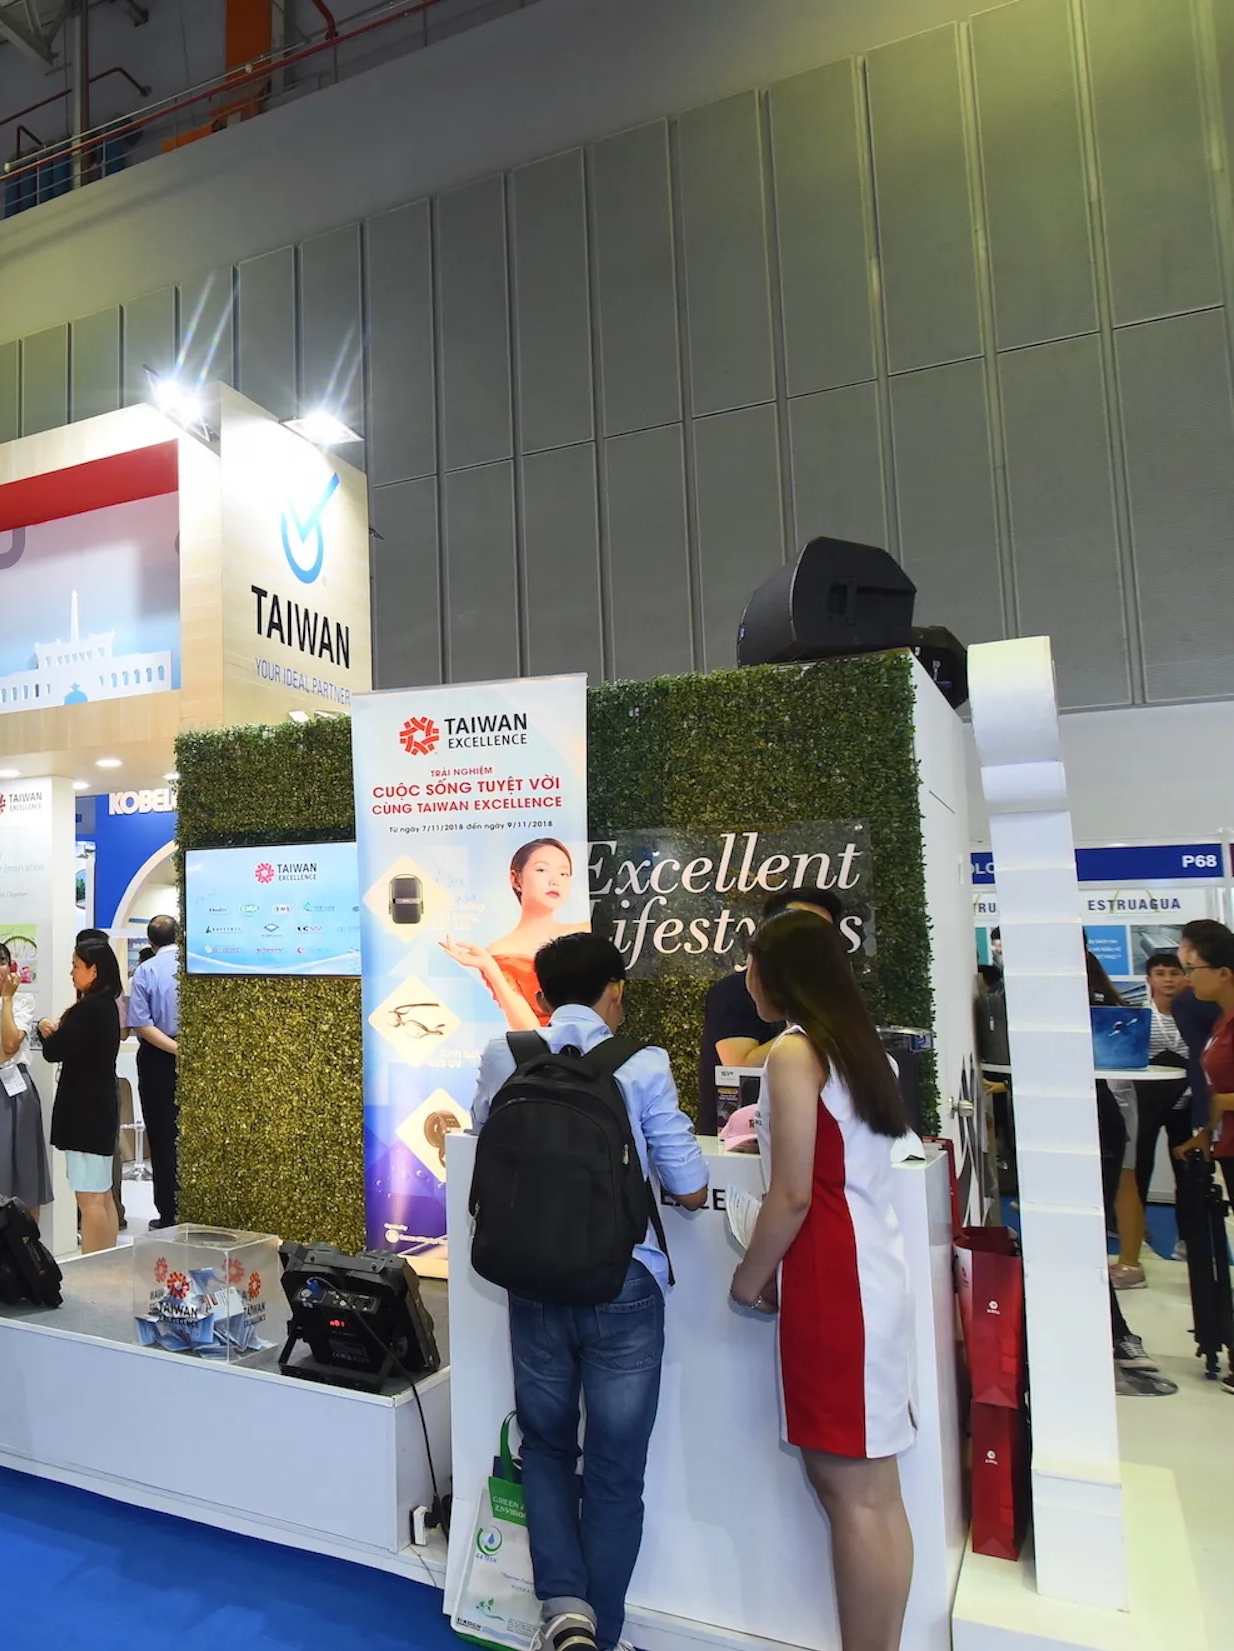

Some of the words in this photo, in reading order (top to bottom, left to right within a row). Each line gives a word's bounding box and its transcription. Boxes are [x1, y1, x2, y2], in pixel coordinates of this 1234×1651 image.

[251, 585, 350, 669] TAIWAN
[255, 658, 282, 683] YOUR
[283, 665, 311, 693] IDEAL
[312, 678, 351, 706] PARTNER
[444, 713, 528, 735] TAIWAN
[448, 733, 528, 749] EXCELLENCE
[373, 782, 421, 801] CUỘC
[426, 779, 472, 796] SỐNG
[478, 776, 523, 795] TUYỆT
[529, 774, 560, 790] VỜI
[8, 792, 43, 803] TAIWAN
[372, 801, 412, 815] CÙNG
[418, 801, 469, 813] TAIWAN
[474, 796, 562, 811] EXCELLENCE
[9, 803, 42, 811] EXCELLENCE
[400, 826, 420, 834] ngày
[422, 823, 464, 832] 7/11/2018
[466, 821, 482, 830] đến
[484, 823, 505, 832] ngày
[507, 820, 553, 829] 9/11/2018
[277, 863, 317, 874] TAIWAN
[587, 831, 864, 896] Excellent
[1182, 855, 1217, 868] P68
[278, 873, 317, 881] EXCELLENCE
[1088, 898, 1181, 911] ESTRUAGUA
[158, 1301, 199, 1318] TAIWAN
